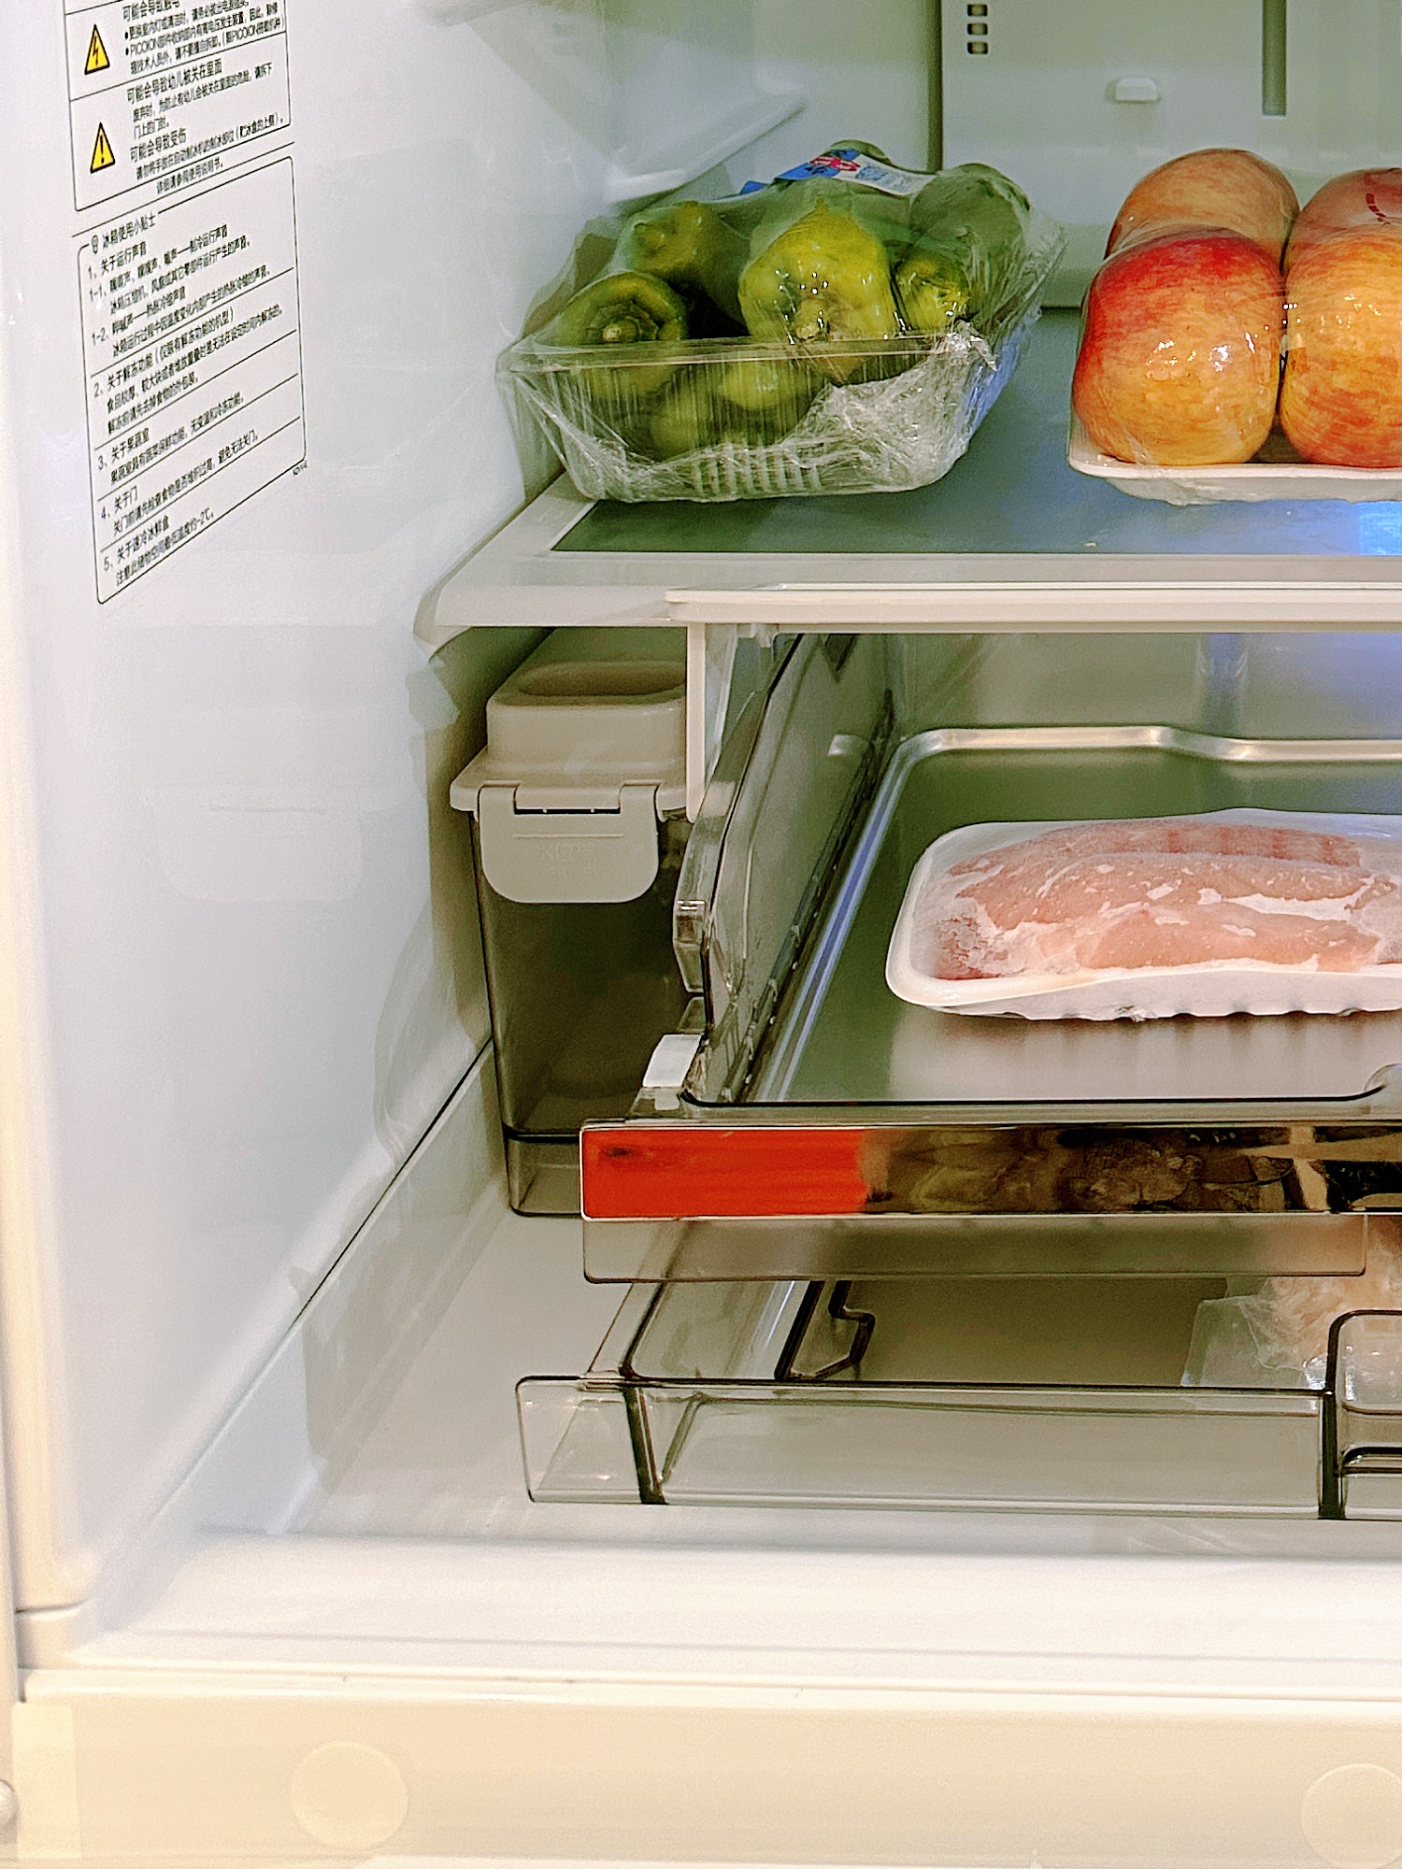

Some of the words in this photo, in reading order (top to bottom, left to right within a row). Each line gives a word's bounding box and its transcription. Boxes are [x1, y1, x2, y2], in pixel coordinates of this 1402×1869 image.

[126, 57, 222, 106] 可能会导致幼儿被关在里面
[129, 125, 187, 164] 可能会导致受伤
